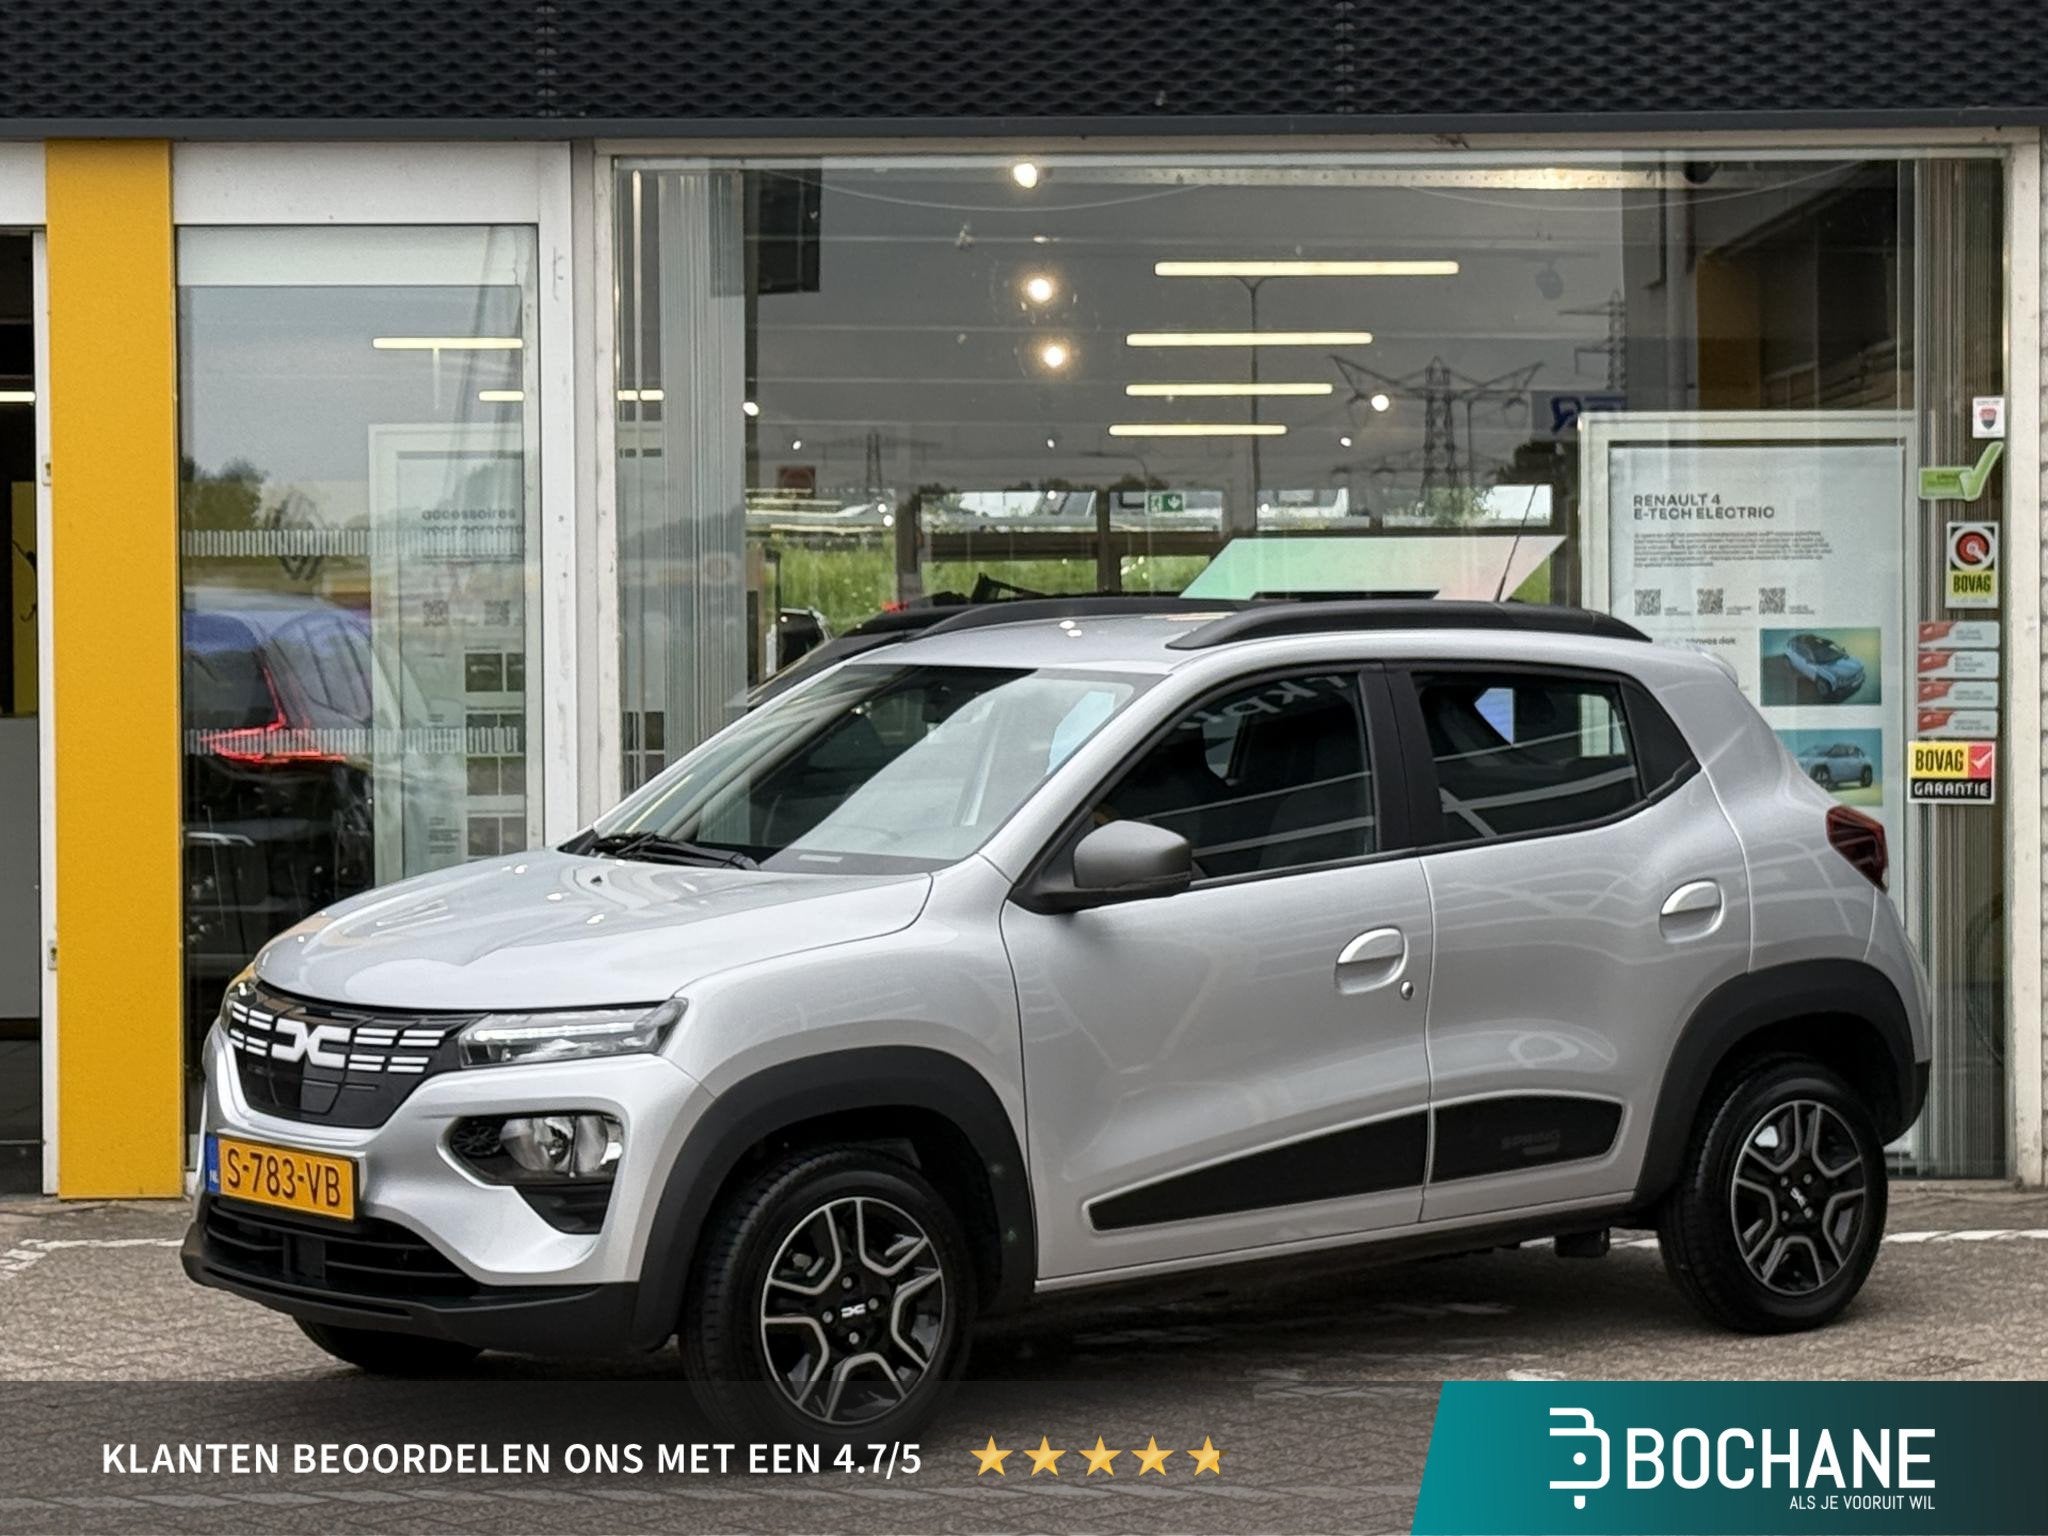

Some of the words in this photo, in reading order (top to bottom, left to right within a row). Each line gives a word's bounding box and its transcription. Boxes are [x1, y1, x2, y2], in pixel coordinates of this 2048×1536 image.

[1633, 494, 1708, 507] RENAULT
[1711, 493, 1721, 506] 4
[1633, 508, 1692, 520] E-TECH
[1696, 507, 1775, 520] ELECTRIC
[1953, 575, 1992, 593] BOVAG
[1915, 749, 1964, 772] BOVAG
[1914, 781, 1990, 797] GARANTIE
[228, 1148, 341, 1207] S-783-VB
